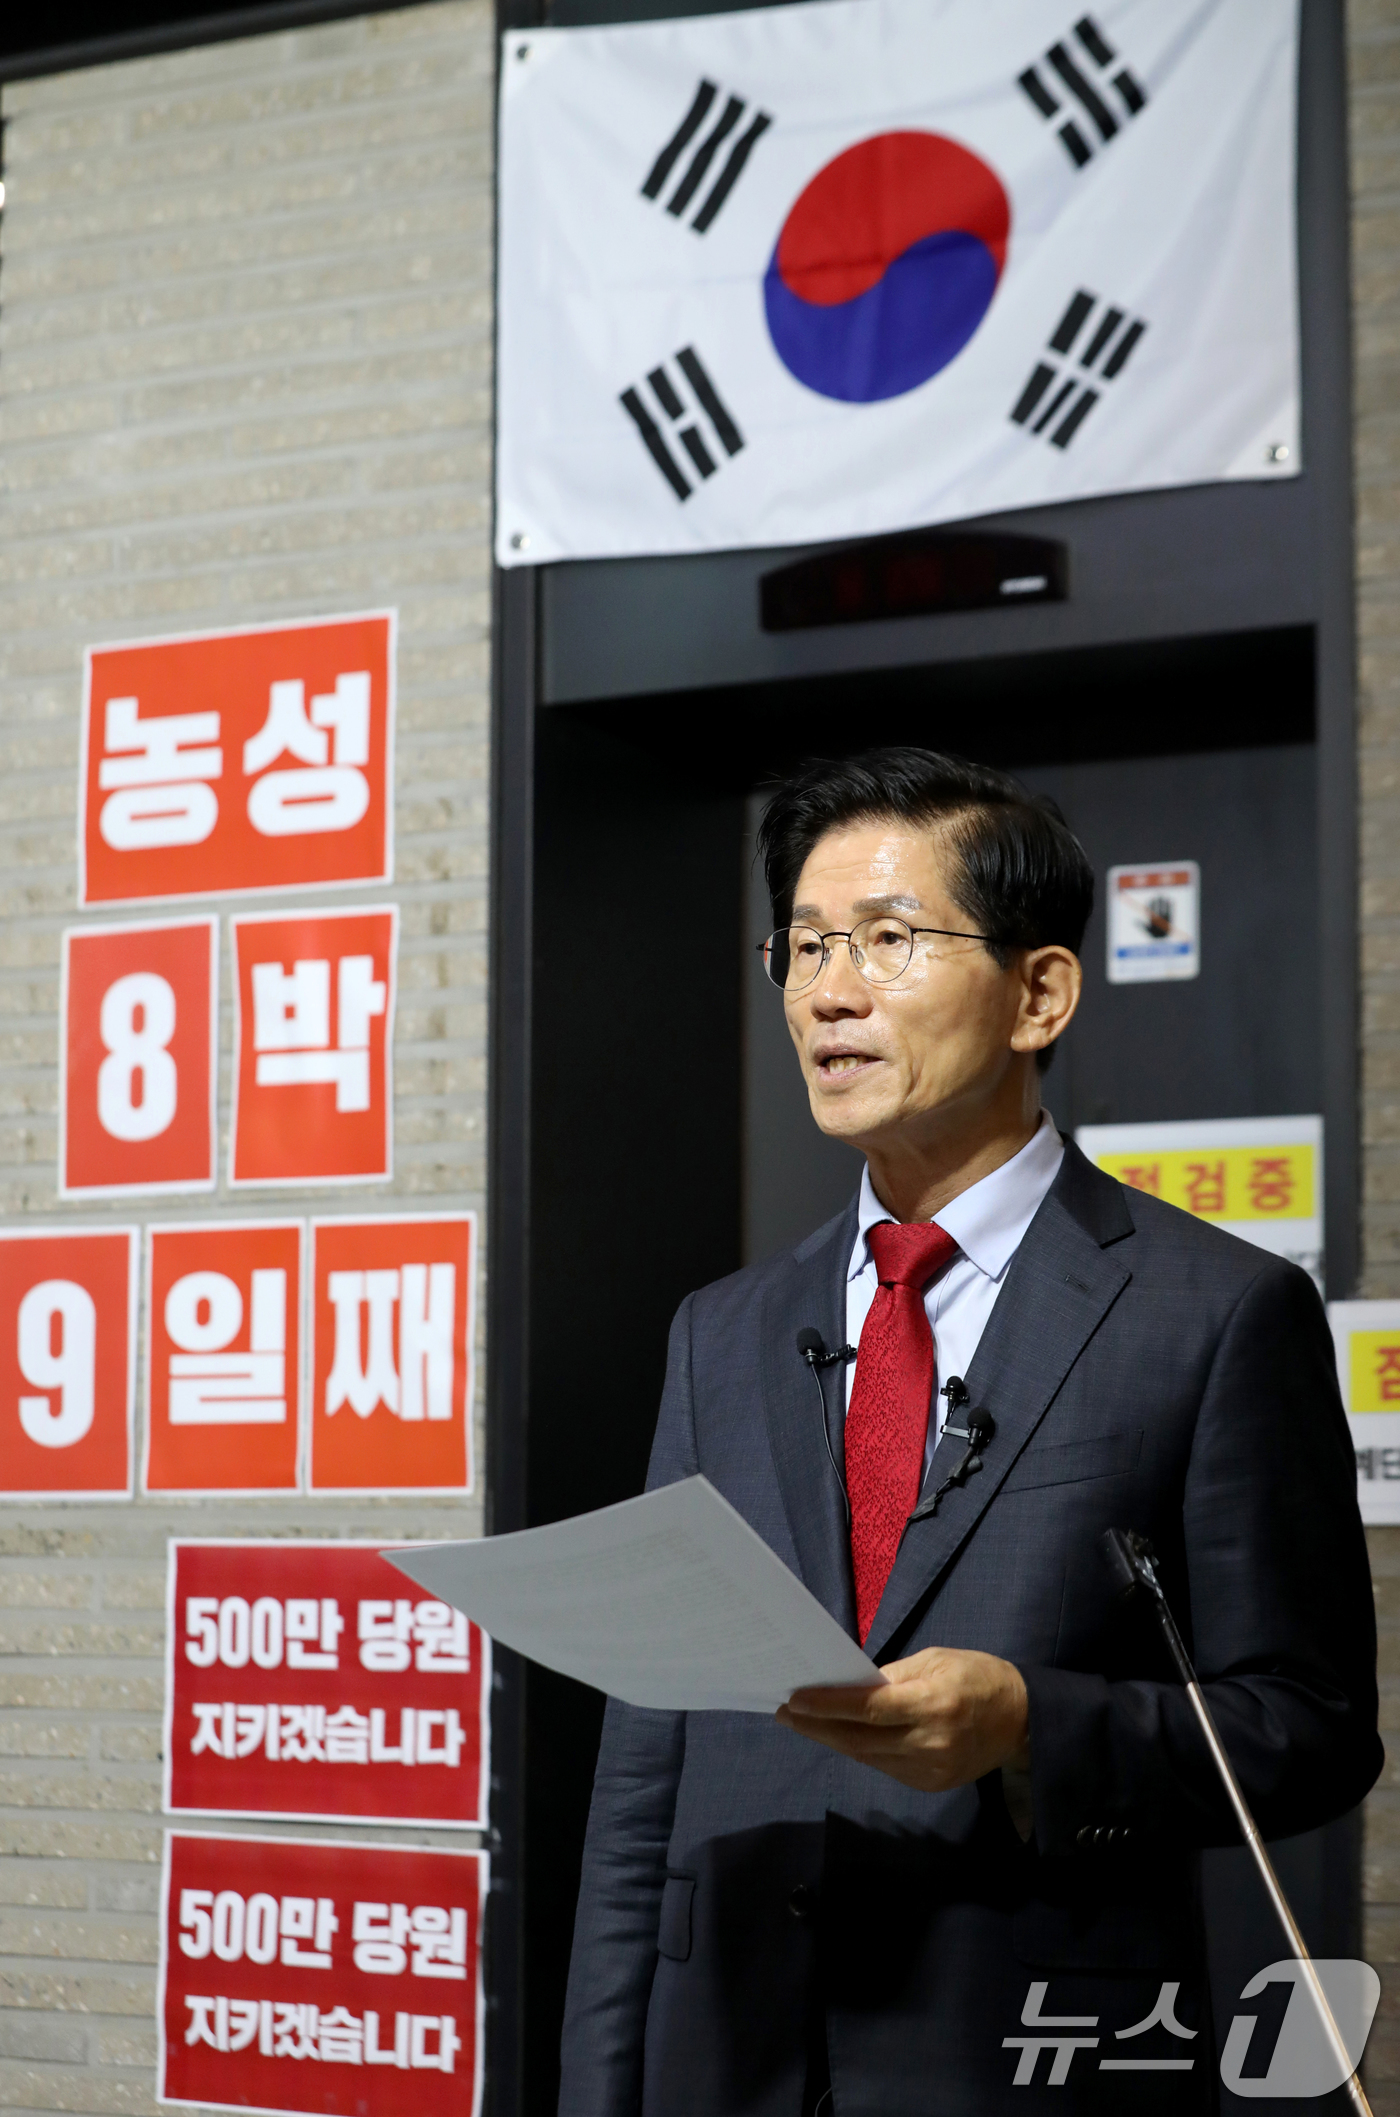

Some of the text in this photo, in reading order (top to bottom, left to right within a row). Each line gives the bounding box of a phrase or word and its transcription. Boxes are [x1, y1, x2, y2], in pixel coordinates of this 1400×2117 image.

[99, 671, 371, 851] 농성
[17, 1262, 456, 1449] 9일째
[184, 1596, 344, 1670] 500만
[357, 1599, 471, 1674] 당원
[190, 1702, 466, 1767] 지키겠습니다
[178, 1888, 467, 1980] 500만 당원
[184, 1994, 461, 2074] 지키겠습니다
